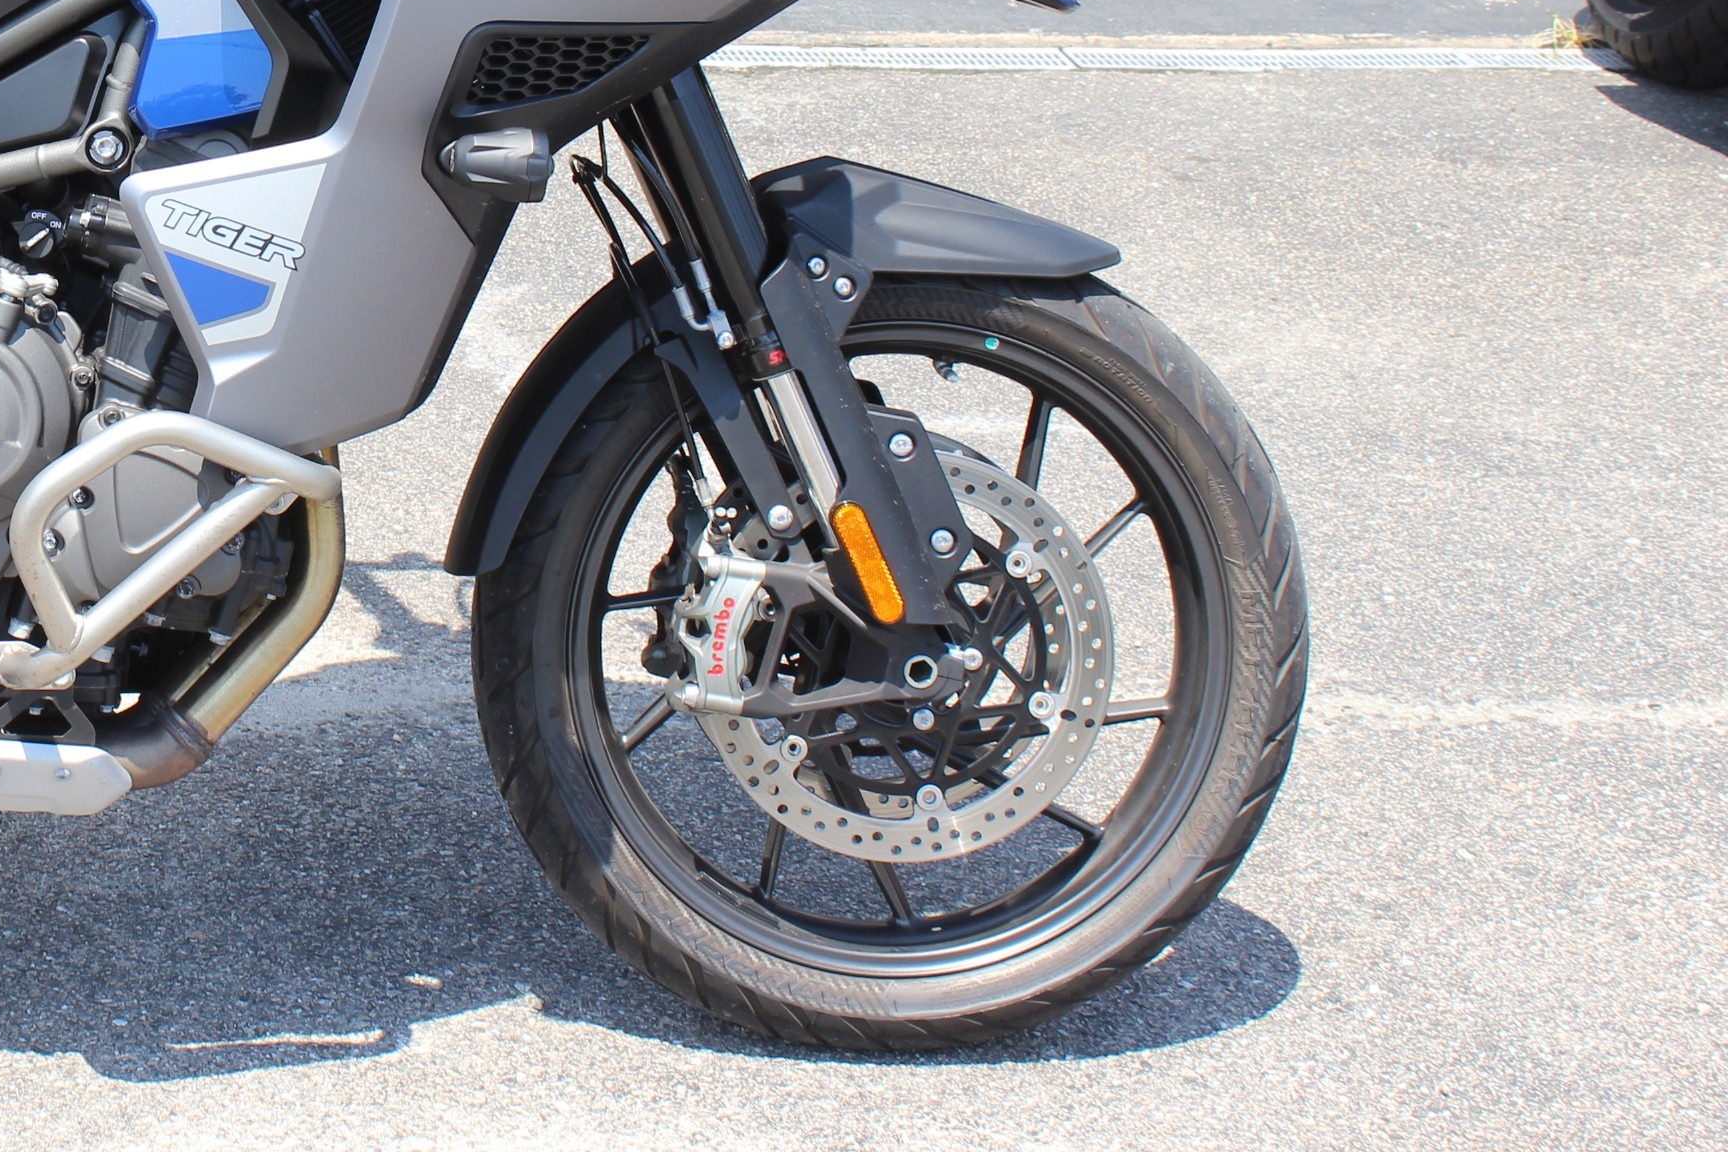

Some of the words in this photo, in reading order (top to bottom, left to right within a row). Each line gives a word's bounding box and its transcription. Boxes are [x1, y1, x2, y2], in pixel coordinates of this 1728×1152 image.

[31, 211, 48, 220] OFF
[49, 220, 62, 229] ON
[161, 198, 306, 272] TIGER
[1093, 355, 1153, 404] ROTATION
[707, 597, 736, 677] brembo
